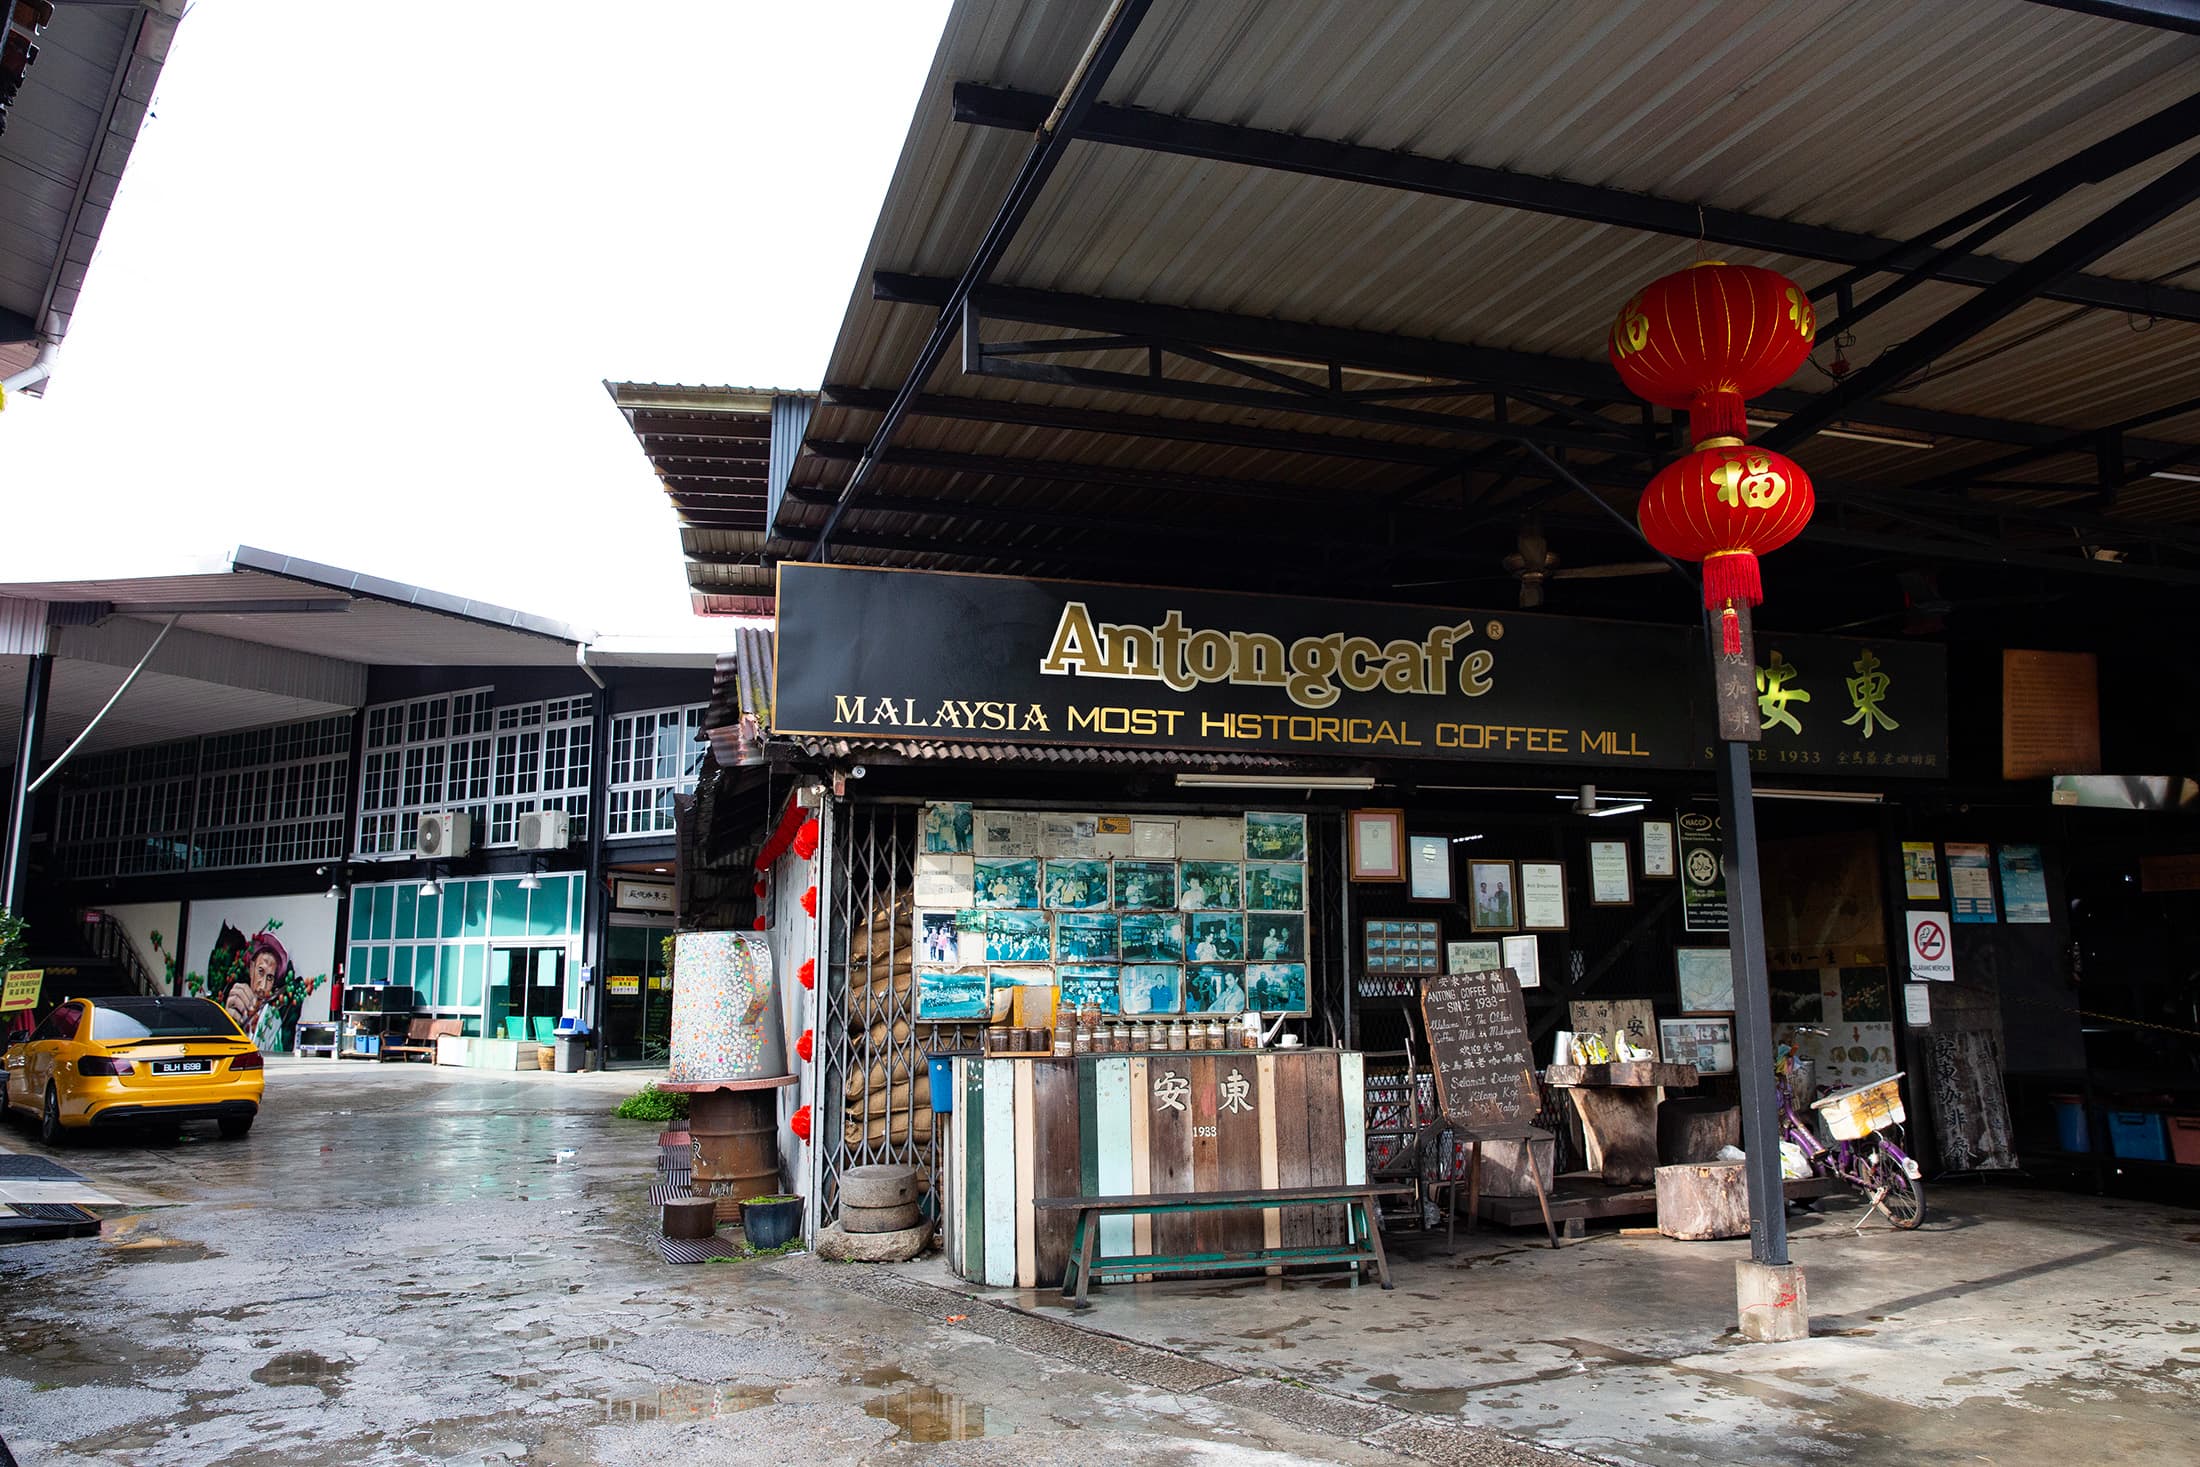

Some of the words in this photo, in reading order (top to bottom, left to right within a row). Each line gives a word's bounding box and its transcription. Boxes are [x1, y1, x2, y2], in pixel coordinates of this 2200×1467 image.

[1710, 450, 1787, 510] 福
[833, 694, 1050, 733] MALAYSIA
[1067, 705, 1185, 736] MOST
[1201, 711, 1422, 747] HISTORICAL
[1435, 722, 1569, 753] COFFEE
[1581, 730, 1650, 756] MILL
[1704, 746, 1768, 761] SCE
[1779, 750, 1822, 764] 1933
[1427, 989, 1456, 1003] ANTONG
[1460, 985, 1487, 999] COFFEE
[1491, 982, 1511, 995] MILL
[163, 1062, 181, 1071] BLH
[1153, 1068, 1255, 1115] 安東
[1193, 1126, 1217, 1138] 1933
